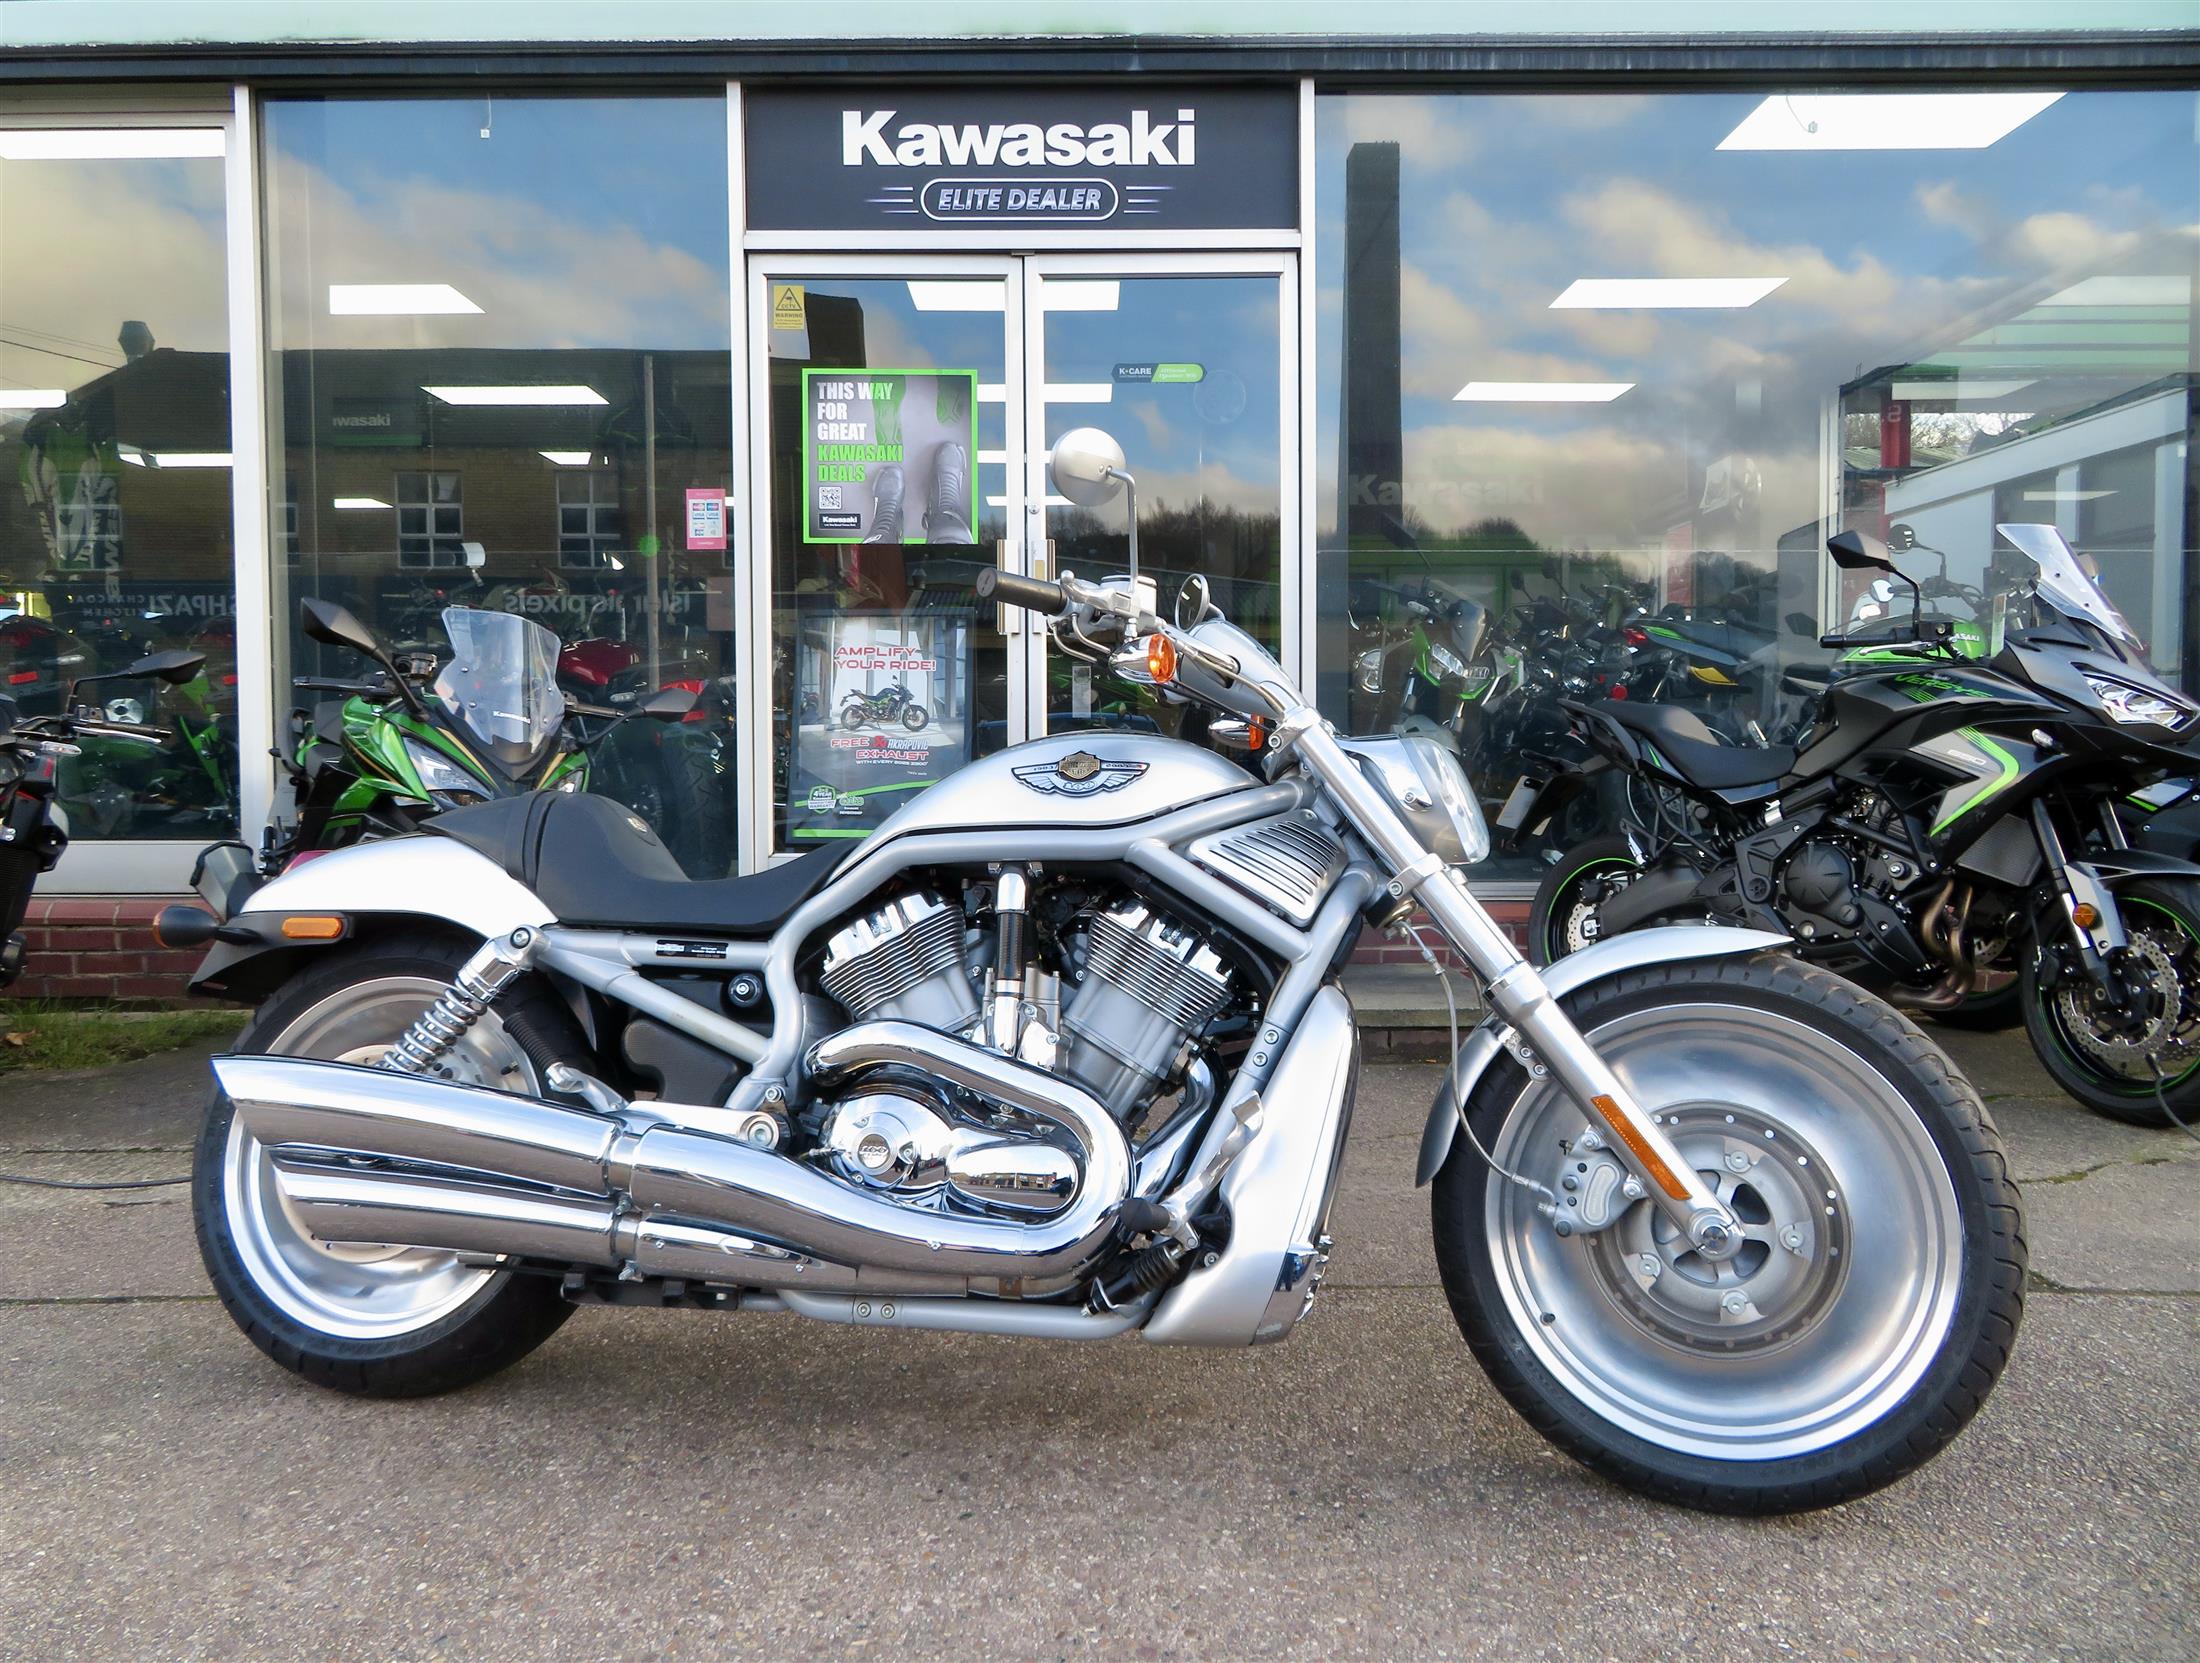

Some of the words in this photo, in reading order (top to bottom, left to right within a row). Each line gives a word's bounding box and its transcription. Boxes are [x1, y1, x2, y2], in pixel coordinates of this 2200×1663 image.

[842, 109, 1195, 166] Kawasaki
[938, 188, 1002, 210] ELITE
[1007, 188, 1102, 210] DEALER
[817, 382, 854, 400] THIS
[858, 382, 894, 400] WAY
[817, 402, 848, 420] FOR
[817, 423, 867, 441] GREAT
[817, 444, 904, 462] KAWASAKI
[817, 464, 866, 482] DEALS
[1954, 632, 1980, 641] ASAKI
[836, 647, 916, 657] AMPLIFY
[836, 660, 886, 670] YOUR
[890, 660, 936, 671] RIDE!
[831, 736, 870, 747] FREE
[855, 749, 929, 761] EXHAUST
